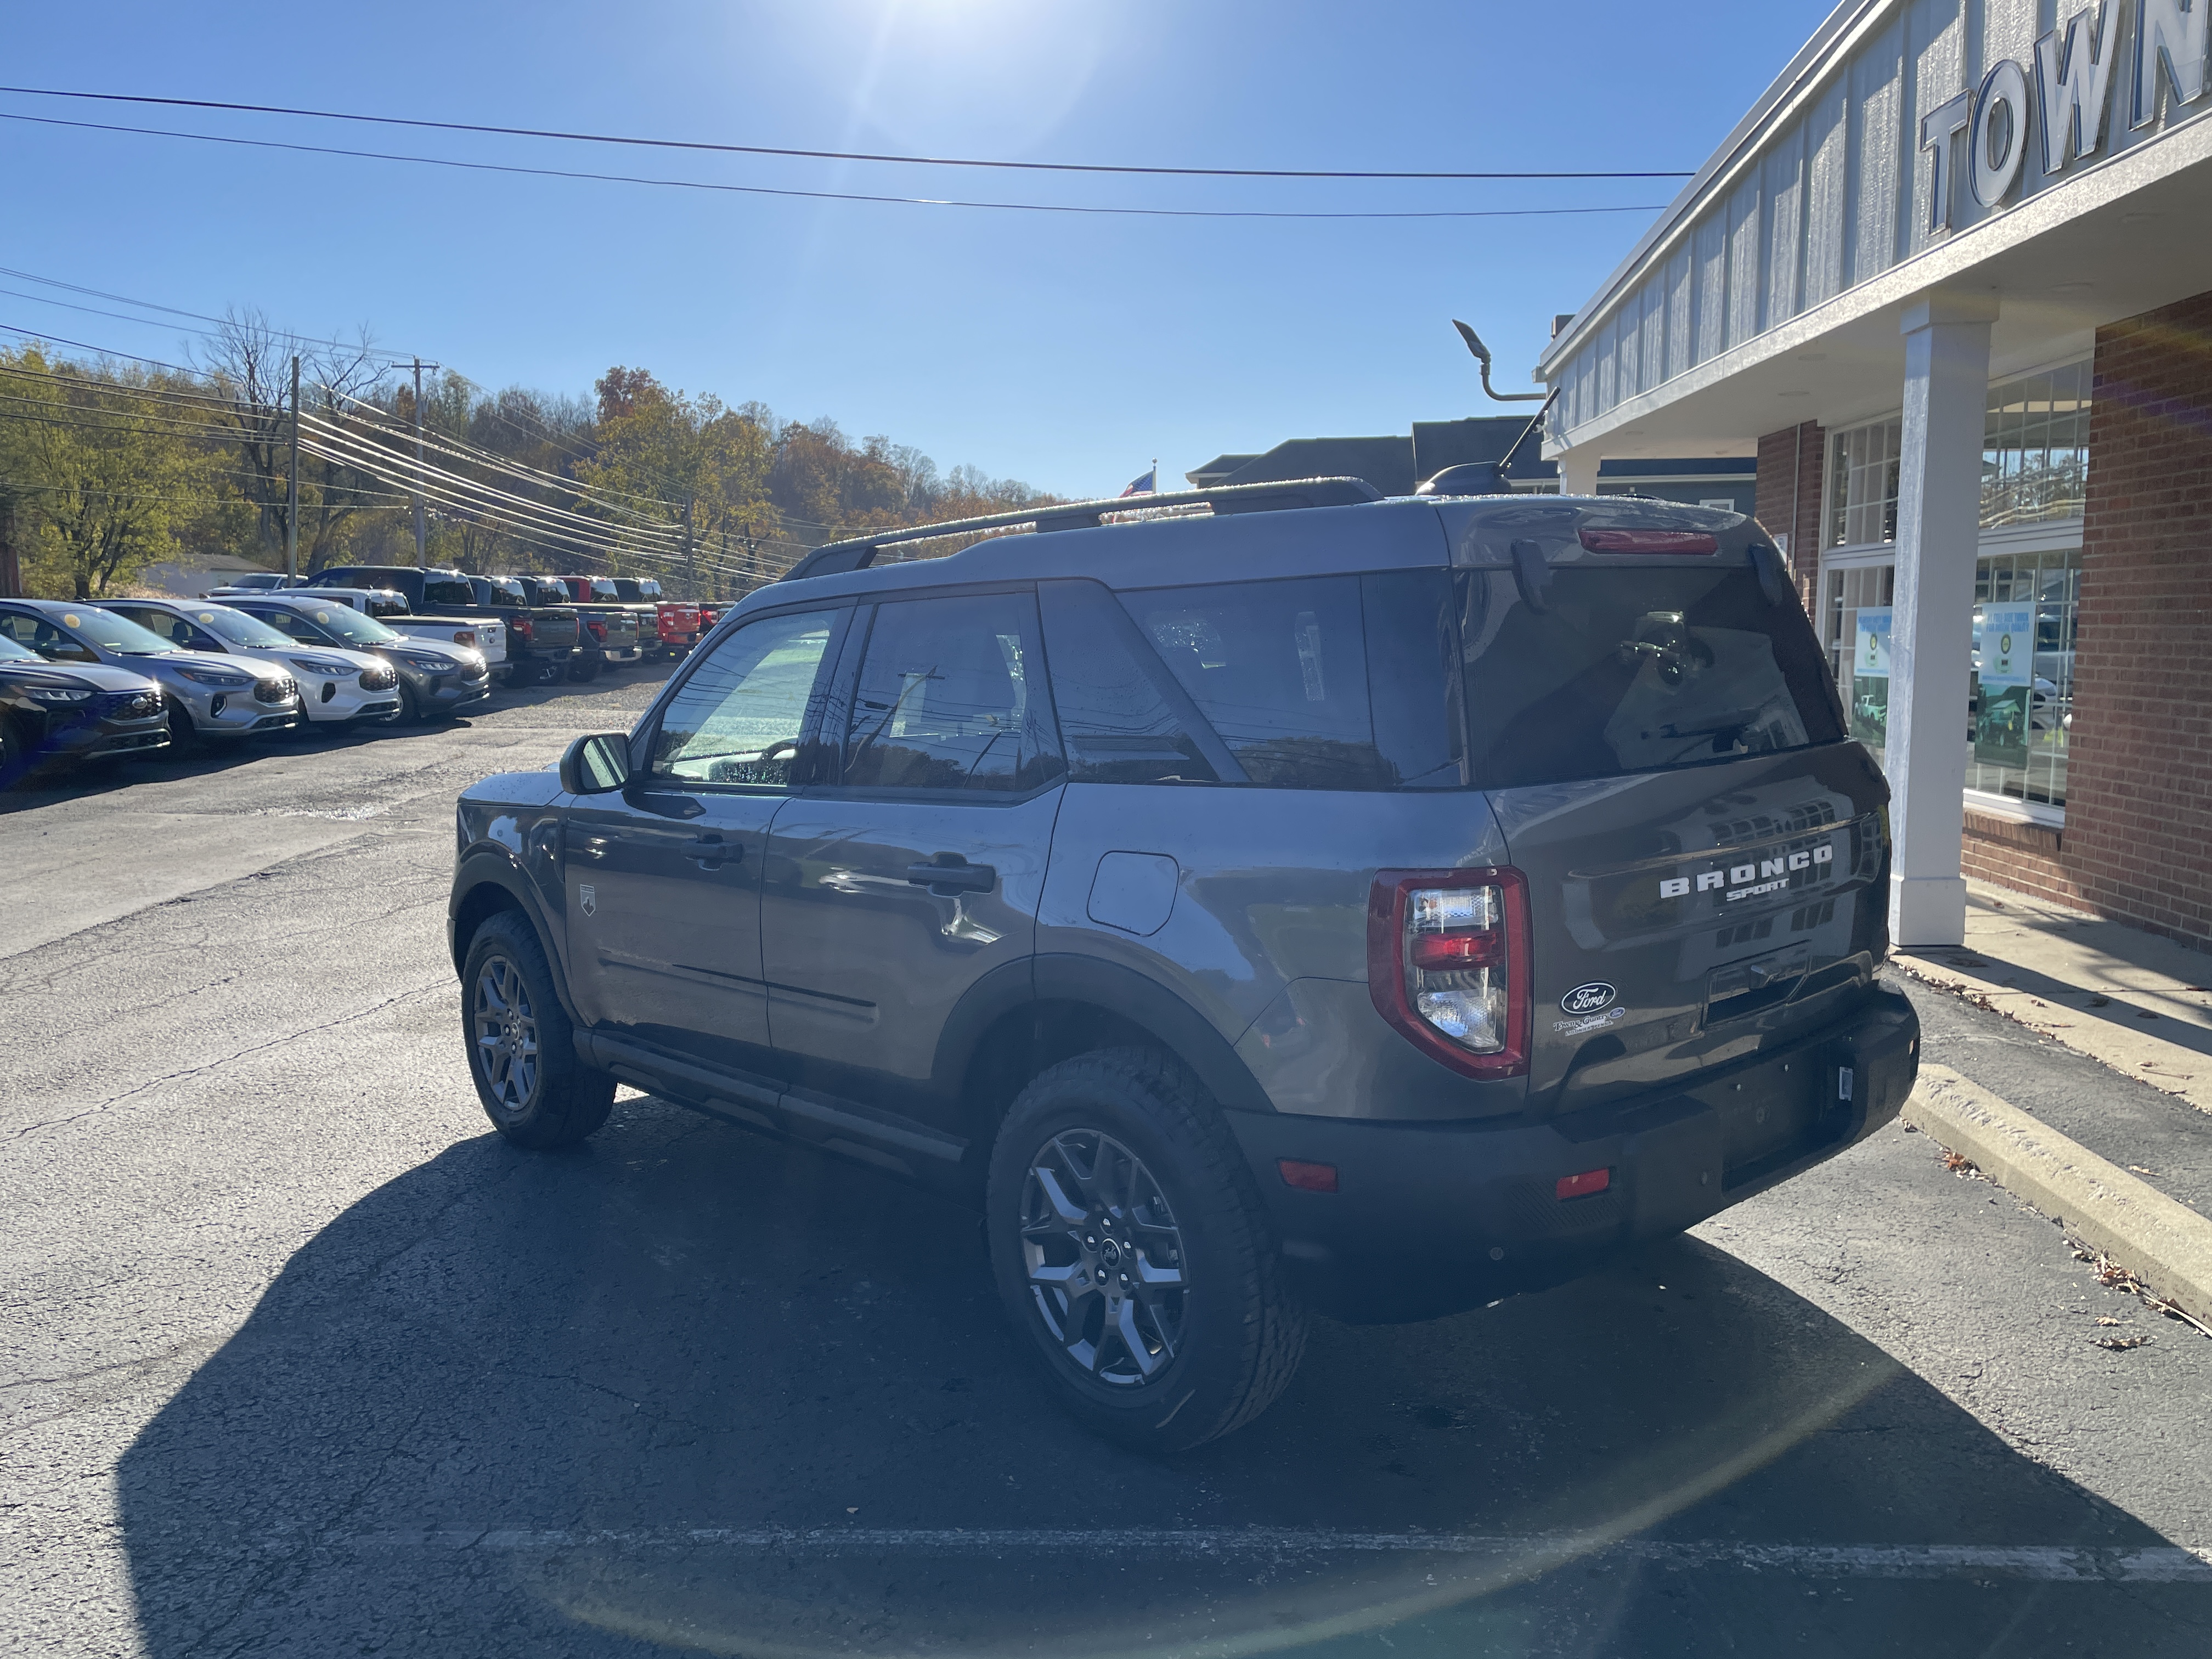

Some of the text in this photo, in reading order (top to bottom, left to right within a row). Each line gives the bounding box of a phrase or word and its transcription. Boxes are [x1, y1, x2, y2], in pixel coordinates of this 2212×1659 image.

[1920, 0, 2208, 236] TOWN
[1660, 845, 1832, 899] BRONCO
[1726, 878, 1790, 901] SPORT
[1573, 988, 1607, 1009] Ford
[1554, 1020, 1575, 1031] Town
